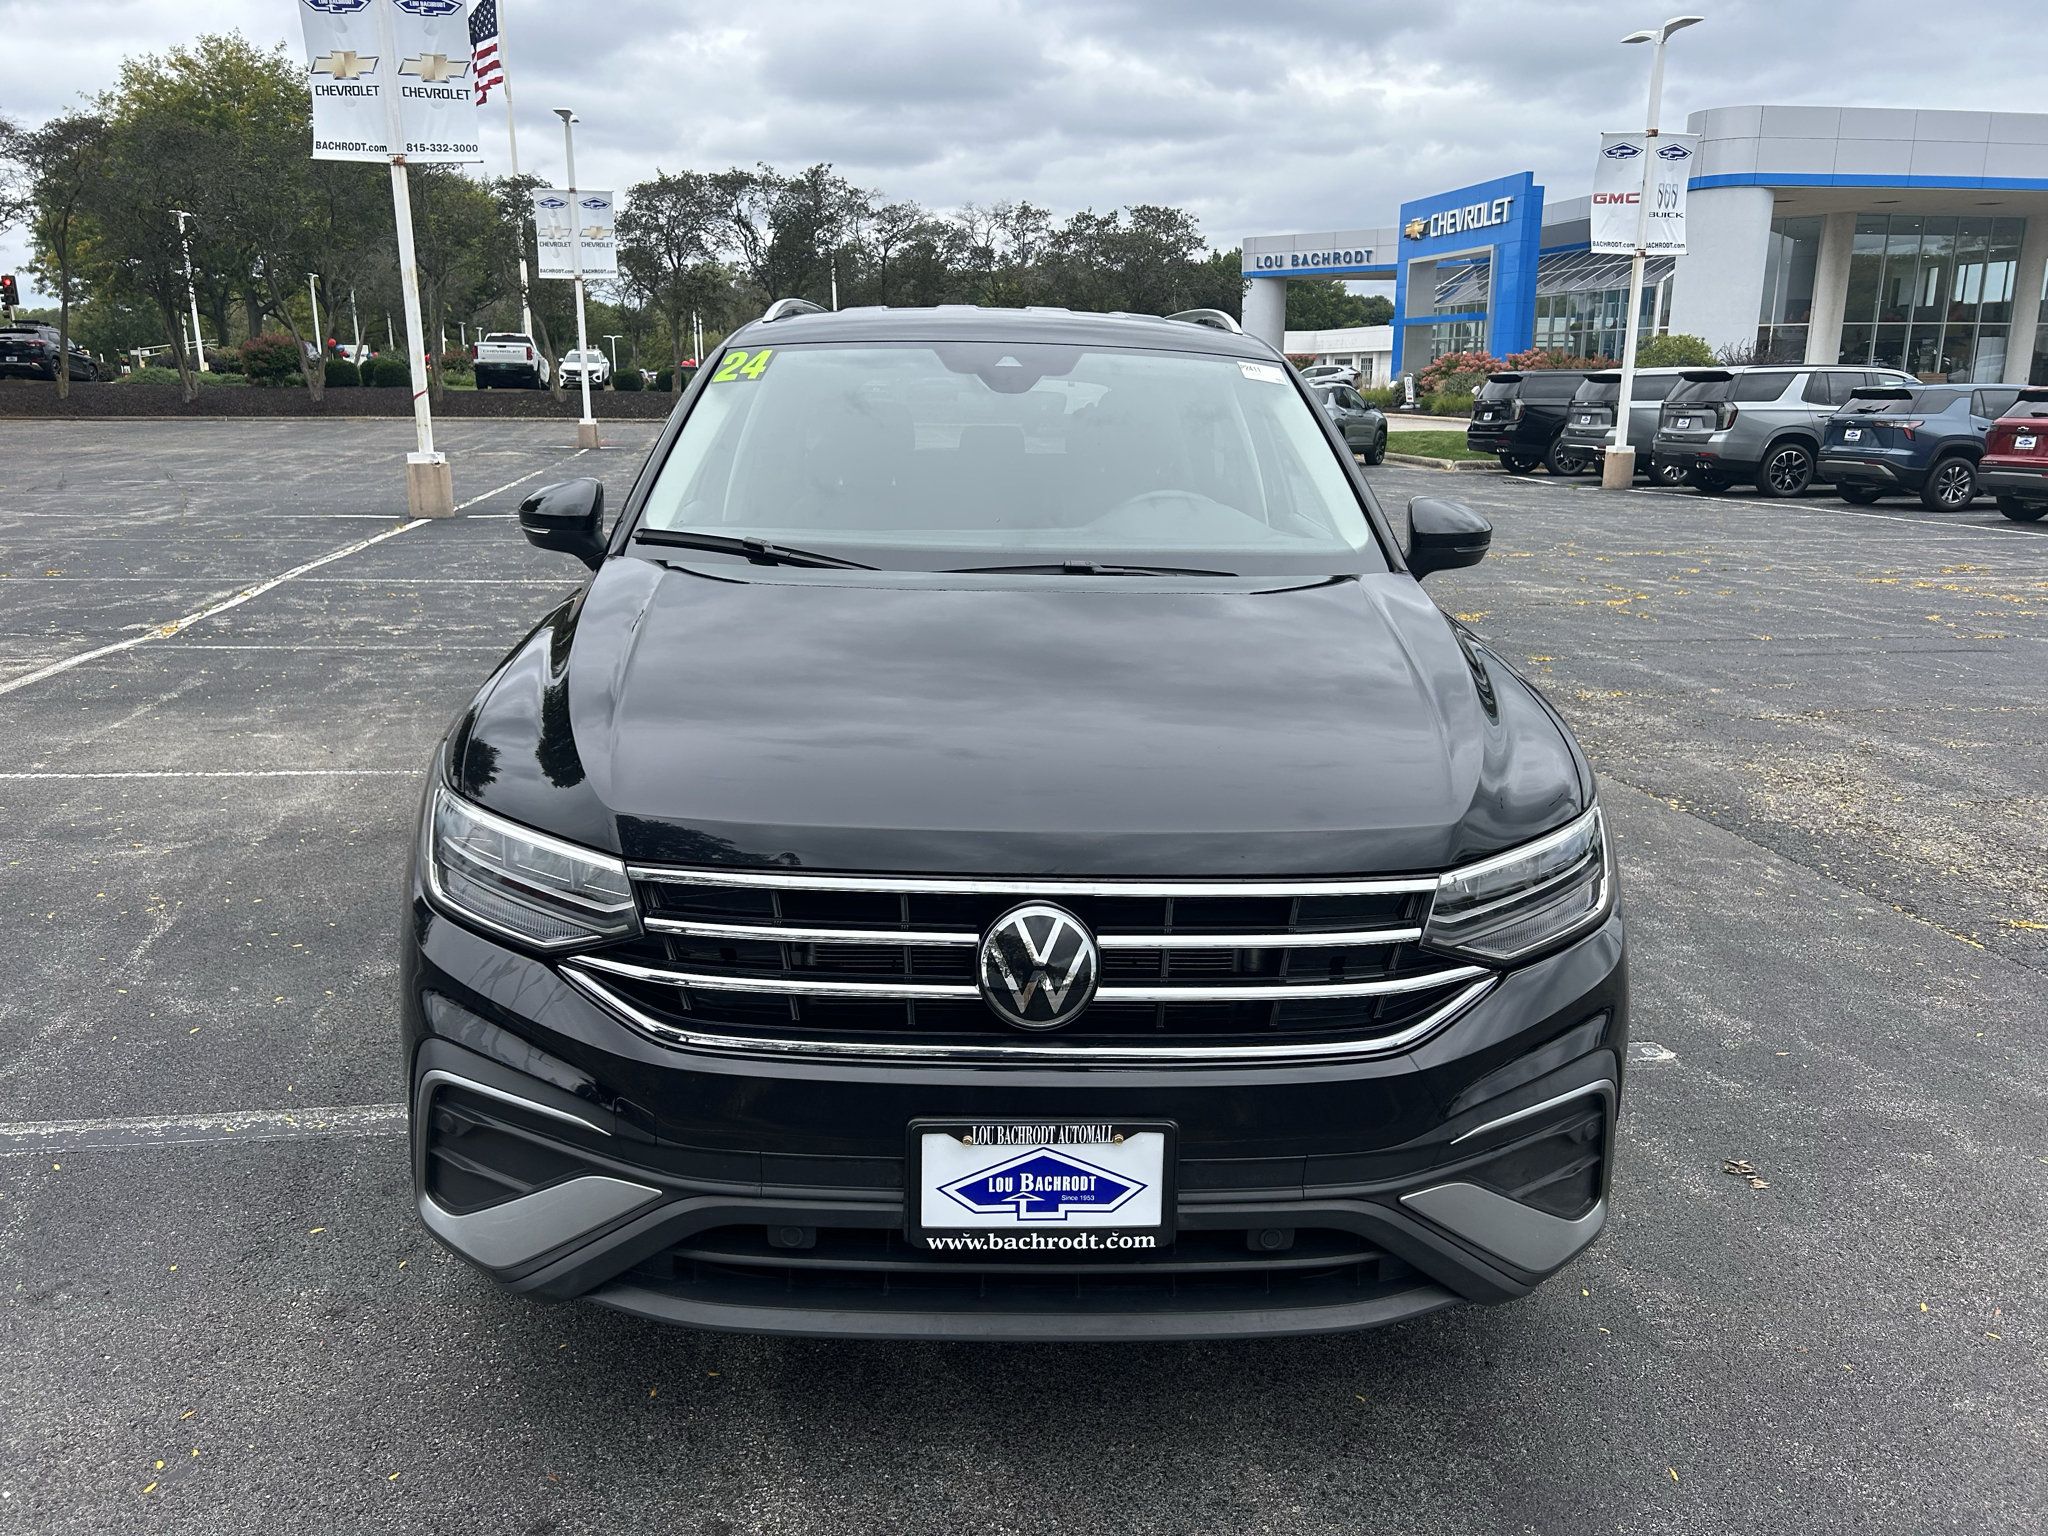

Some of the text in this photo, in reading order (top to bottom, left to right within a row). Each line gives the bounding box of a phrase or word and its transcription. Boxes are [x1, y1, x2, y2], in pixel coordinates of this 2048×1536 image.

[315, 85, 379, 97] CHEVROLET
[402, 86, 471, 100] CHEVROLET
[315, 141, 388, 152] BACHRODT.com
[406, 143, 478, 153] 815-332-3000
[1593, 192, 1641, 204] GMC
[1429, 197, 1512, 237] CHEVROLET
[1649, 211, 1684, 219] BUICK
[1593, 240, 1636, 249] BACHRODT.com
[1256, 249, 1373, 269] LOU BACHRODT
[713, 350, 773, 382] 24
[972, 1125, 1114, 1146] LOU BACHRODT AUTOMALL
[988, 1173, 1097, 1193] LOU BACHRODT
[1061, 1194, 1078, 1202] Since
[926, 1232, 1156, 1250] www.bachrodt.com
